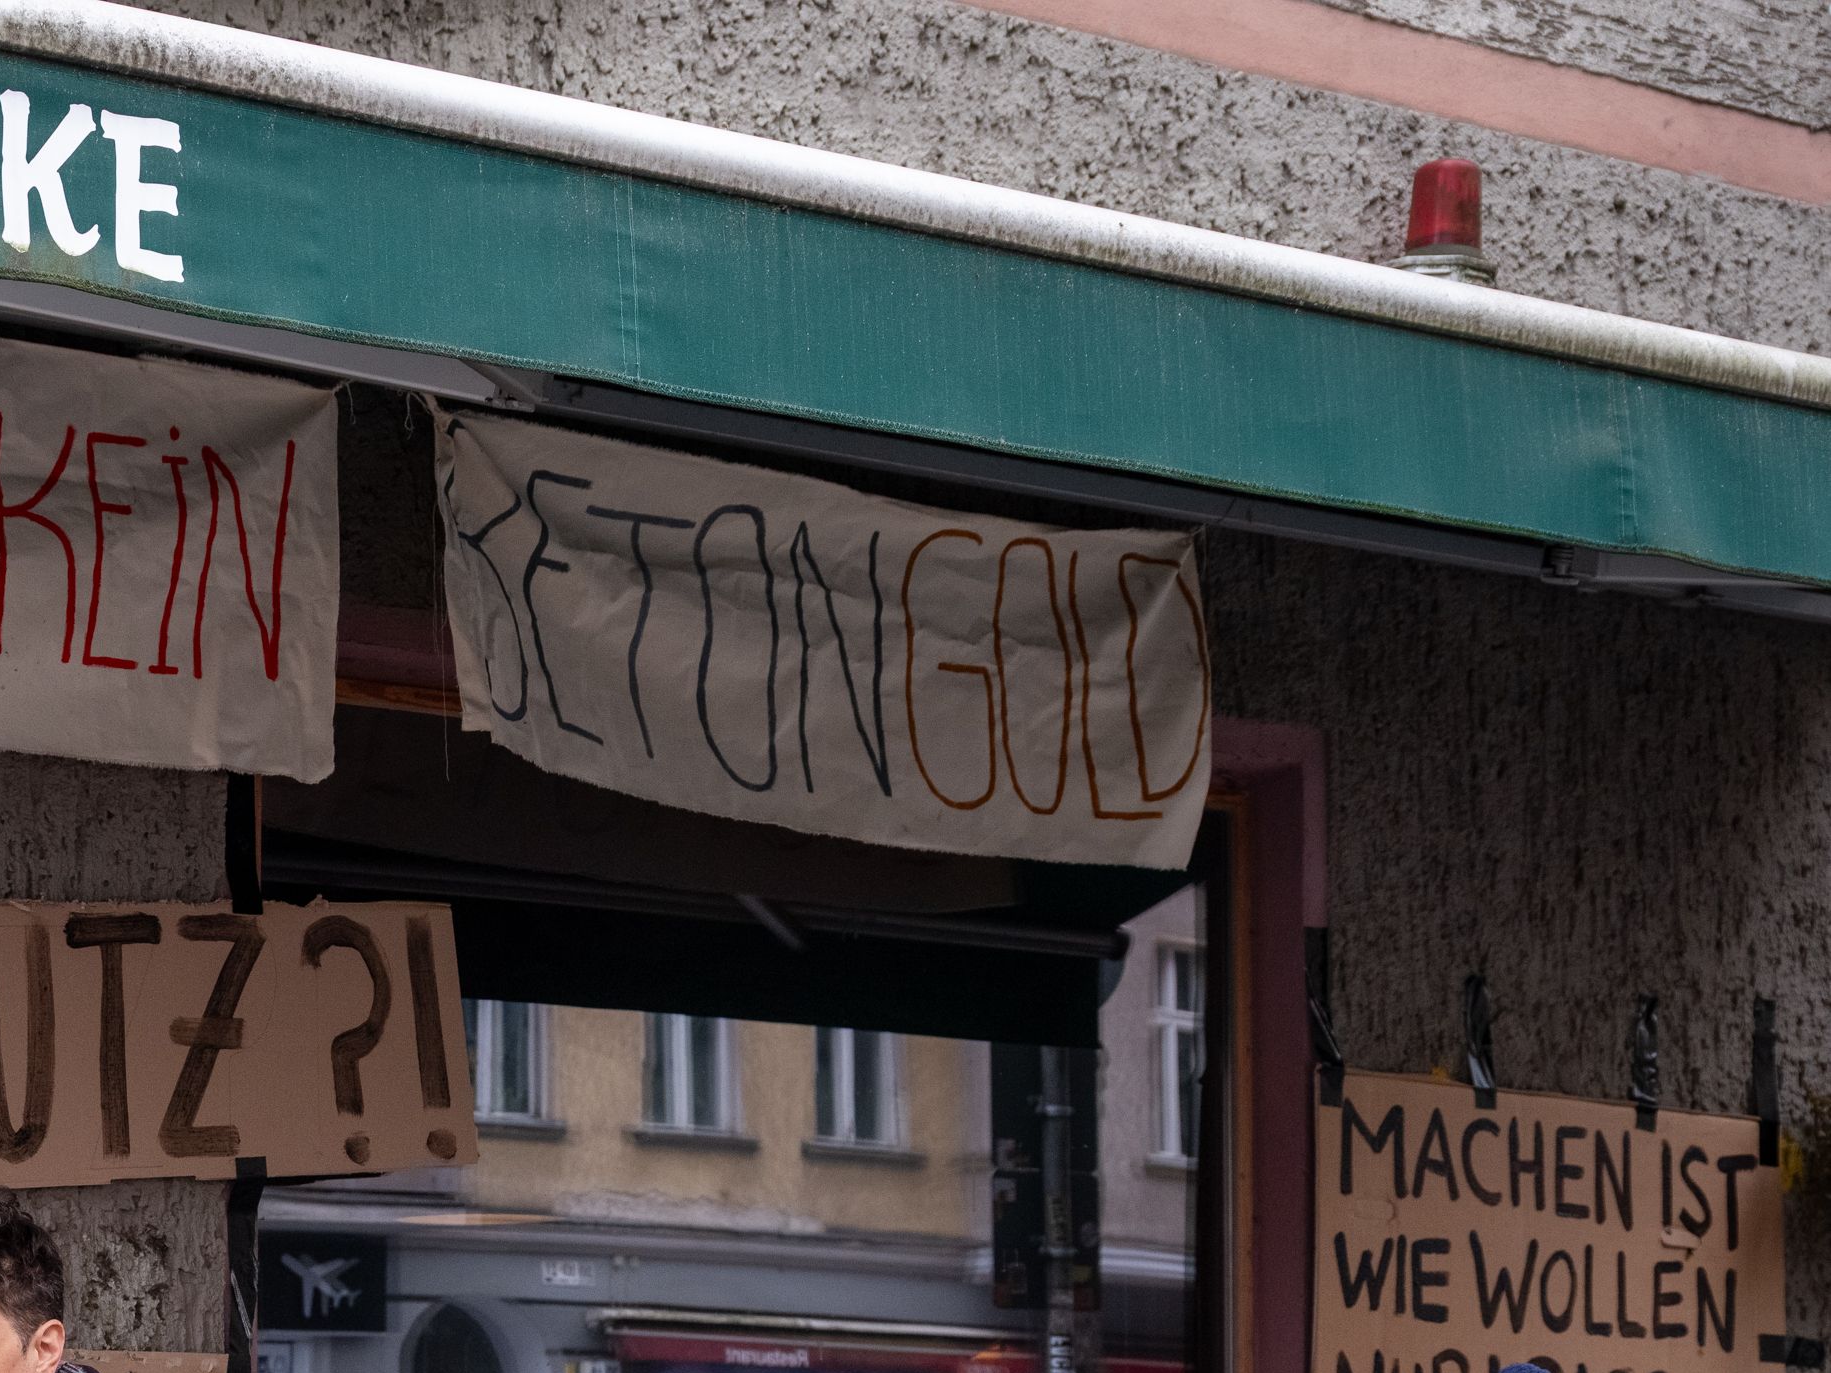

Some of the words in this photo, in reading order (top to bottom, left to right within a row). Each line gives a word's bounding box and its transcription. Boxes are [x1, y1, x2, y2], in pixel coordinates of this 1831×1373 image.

[1339, 1096, 1634, 1232] MACHEN
[1660, 1139, 1758, 1252] IST
[1333, 1231, 1451, 1324] WIE
[1469, 1230, 1738, 1353] WOLLEN
